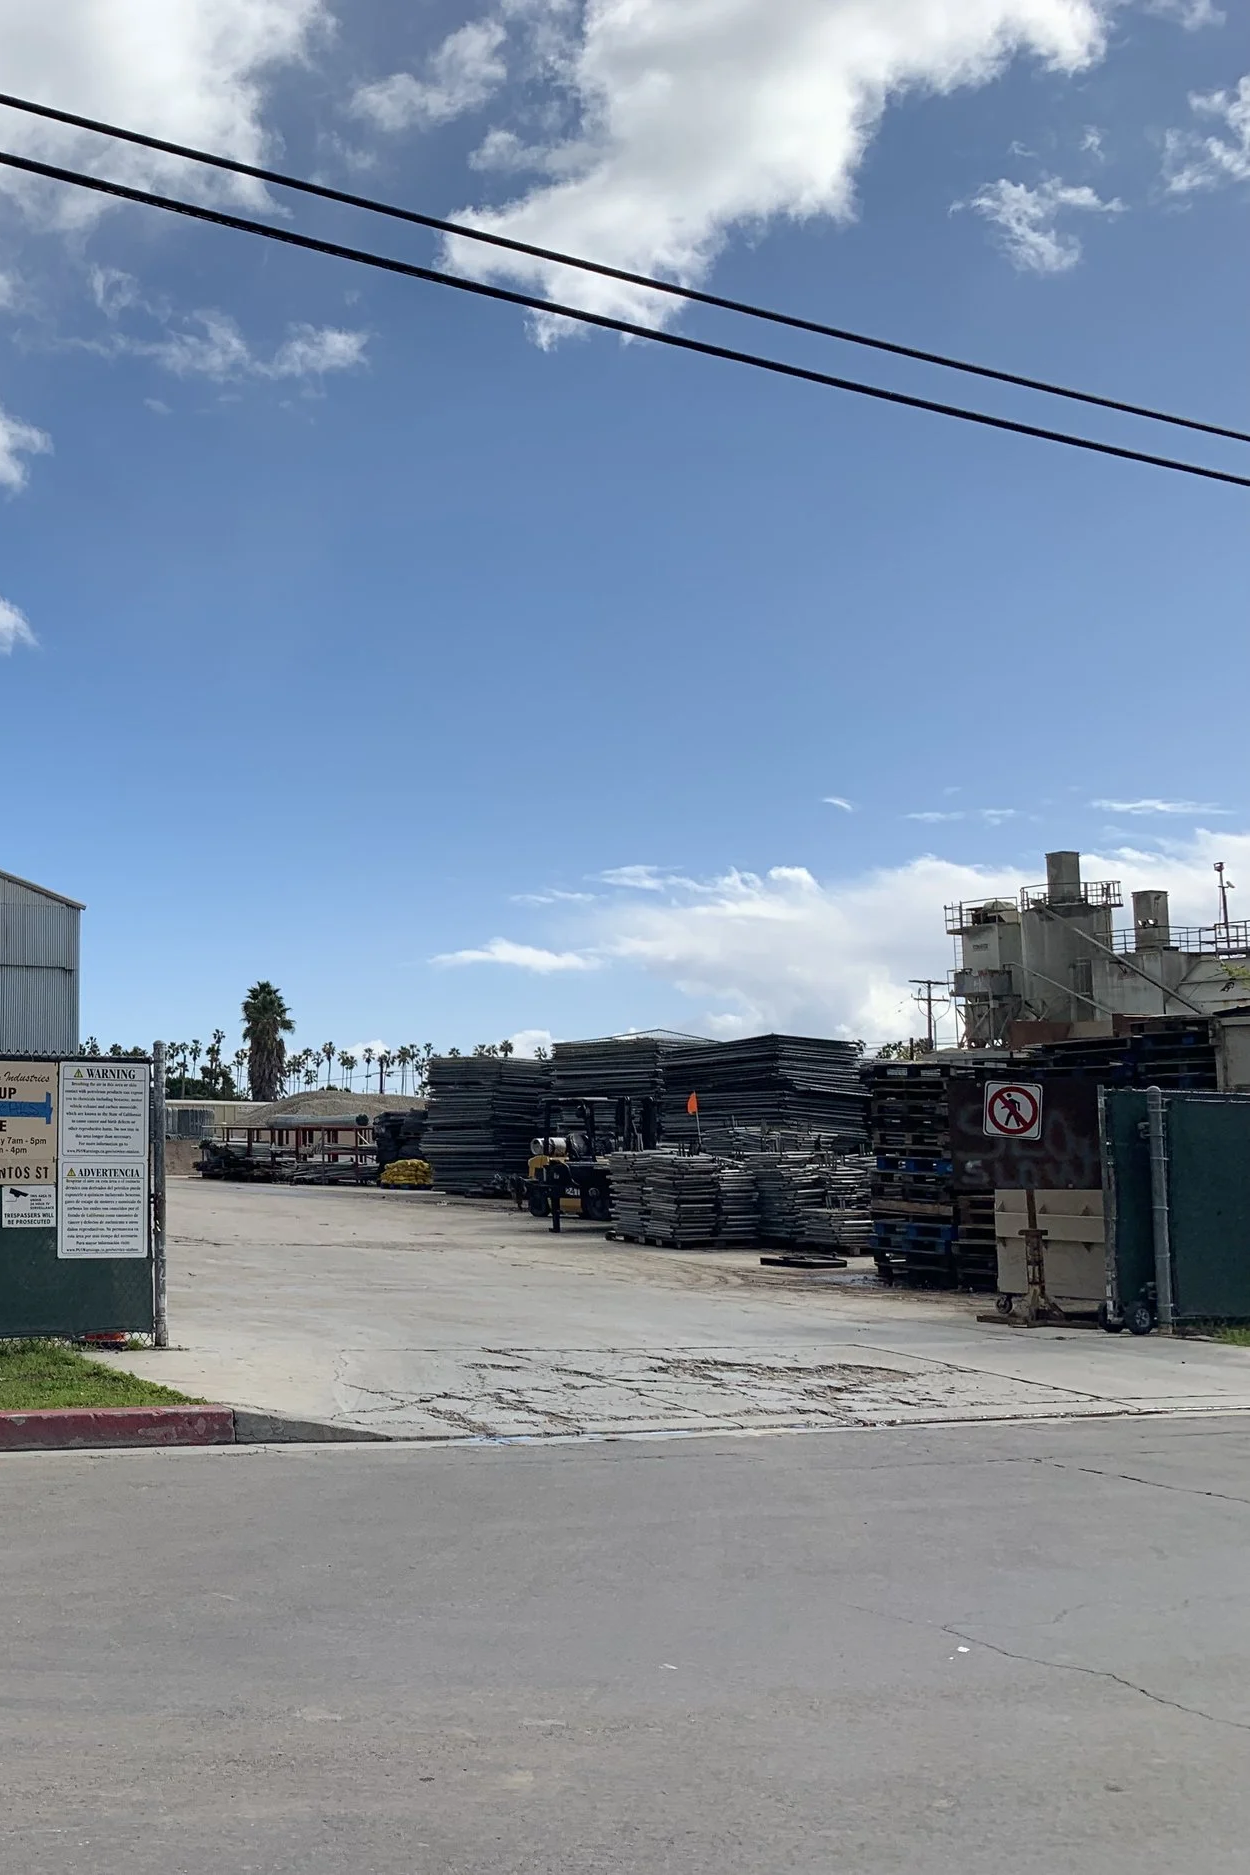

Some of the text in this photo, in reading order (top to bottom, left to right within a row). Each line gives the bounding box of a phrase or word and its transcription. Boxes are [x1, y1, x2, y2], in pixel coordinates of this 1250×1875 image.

[3, 1071, 50, 1083] Industries
[86, 1068, 136, 1080] WARNING
[0, 1087, 17, 1099] UP
[7, 1136, 24, 1144] 7am
[30, 1137, 47, 1146] 5pm
[10, 1146, 28, 1156] 4pm
[35, 1166, 49, 1179] ST
[78, 1168, 140, 1177] ADVERTENCIA
